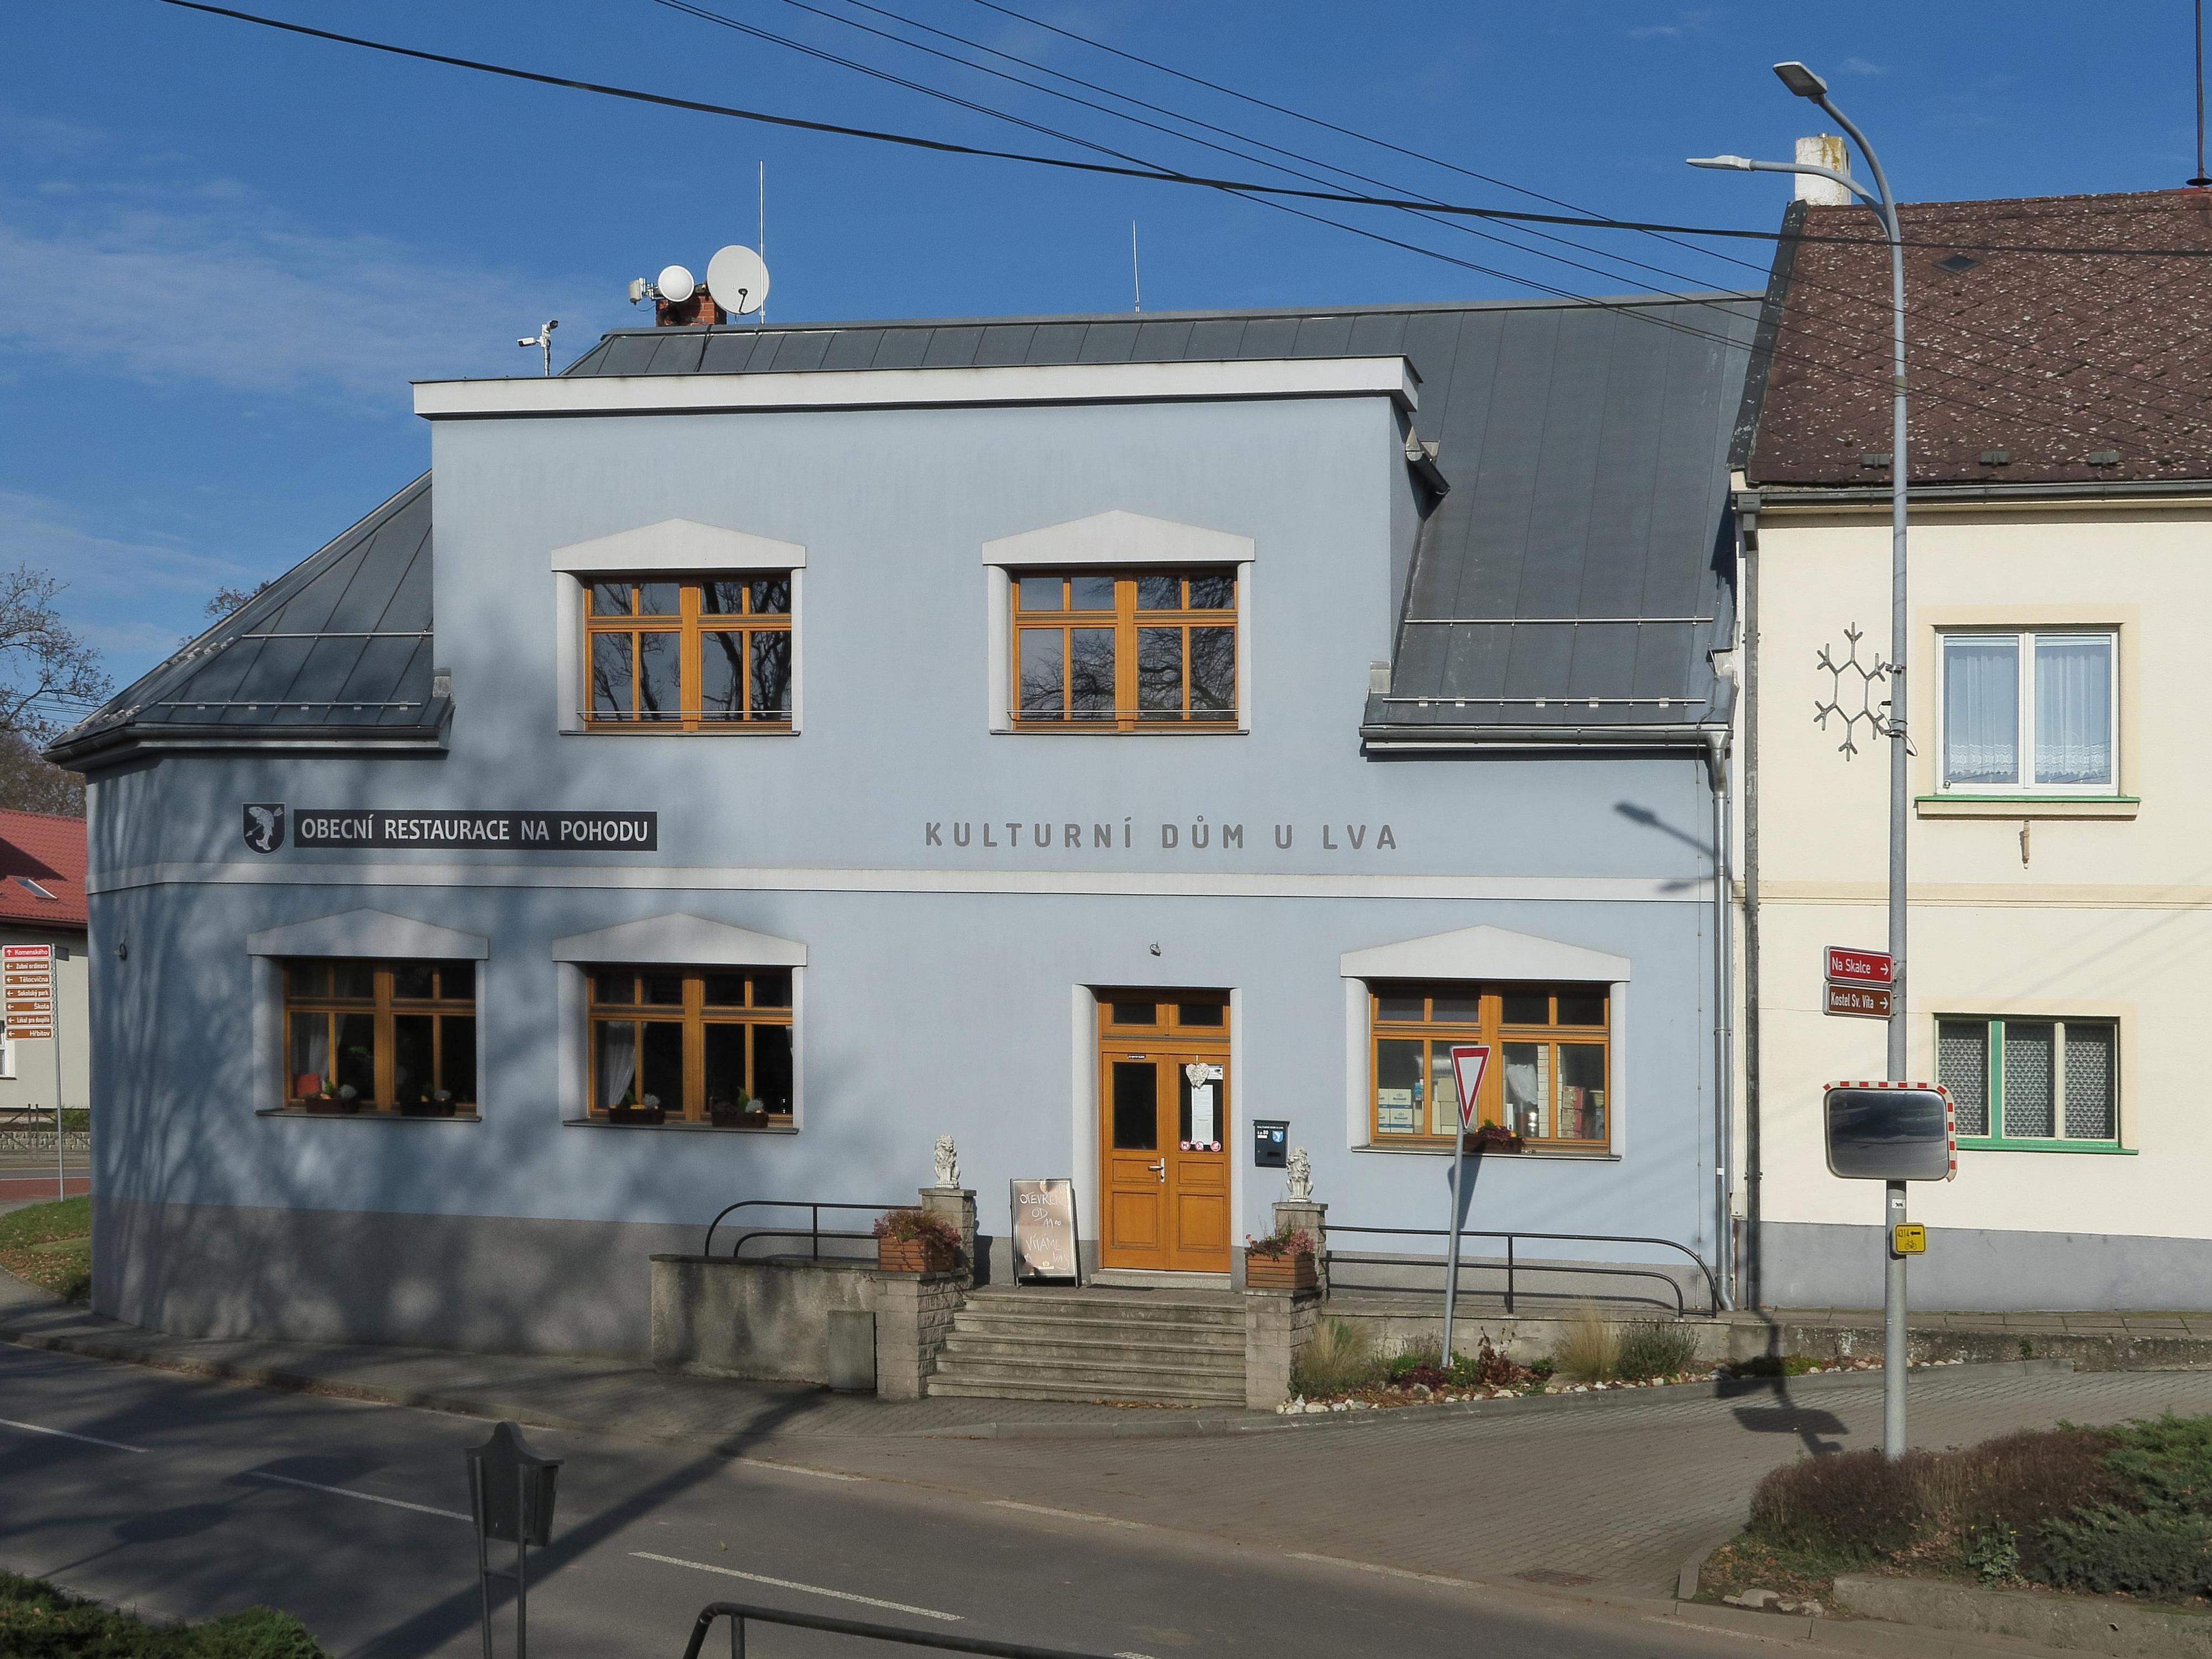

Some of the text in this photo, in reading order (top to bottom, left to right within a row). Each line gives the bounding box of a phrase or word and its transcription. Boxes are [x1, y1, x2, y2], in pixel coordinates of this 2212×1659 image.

[301, 814, 648, 842] OBECNÍ RESTAURACE NA POHODU
[926, 815, 1396, 850] KULTURNÍ DŮM U LVA
[1832, 957, 1871, 974] Na Skalce
[1831, 992, 1850, 1006] Kostel
[1851, 994, 1861, 1008] Sv.
[1031, 1208, 1048, 1221] OD
